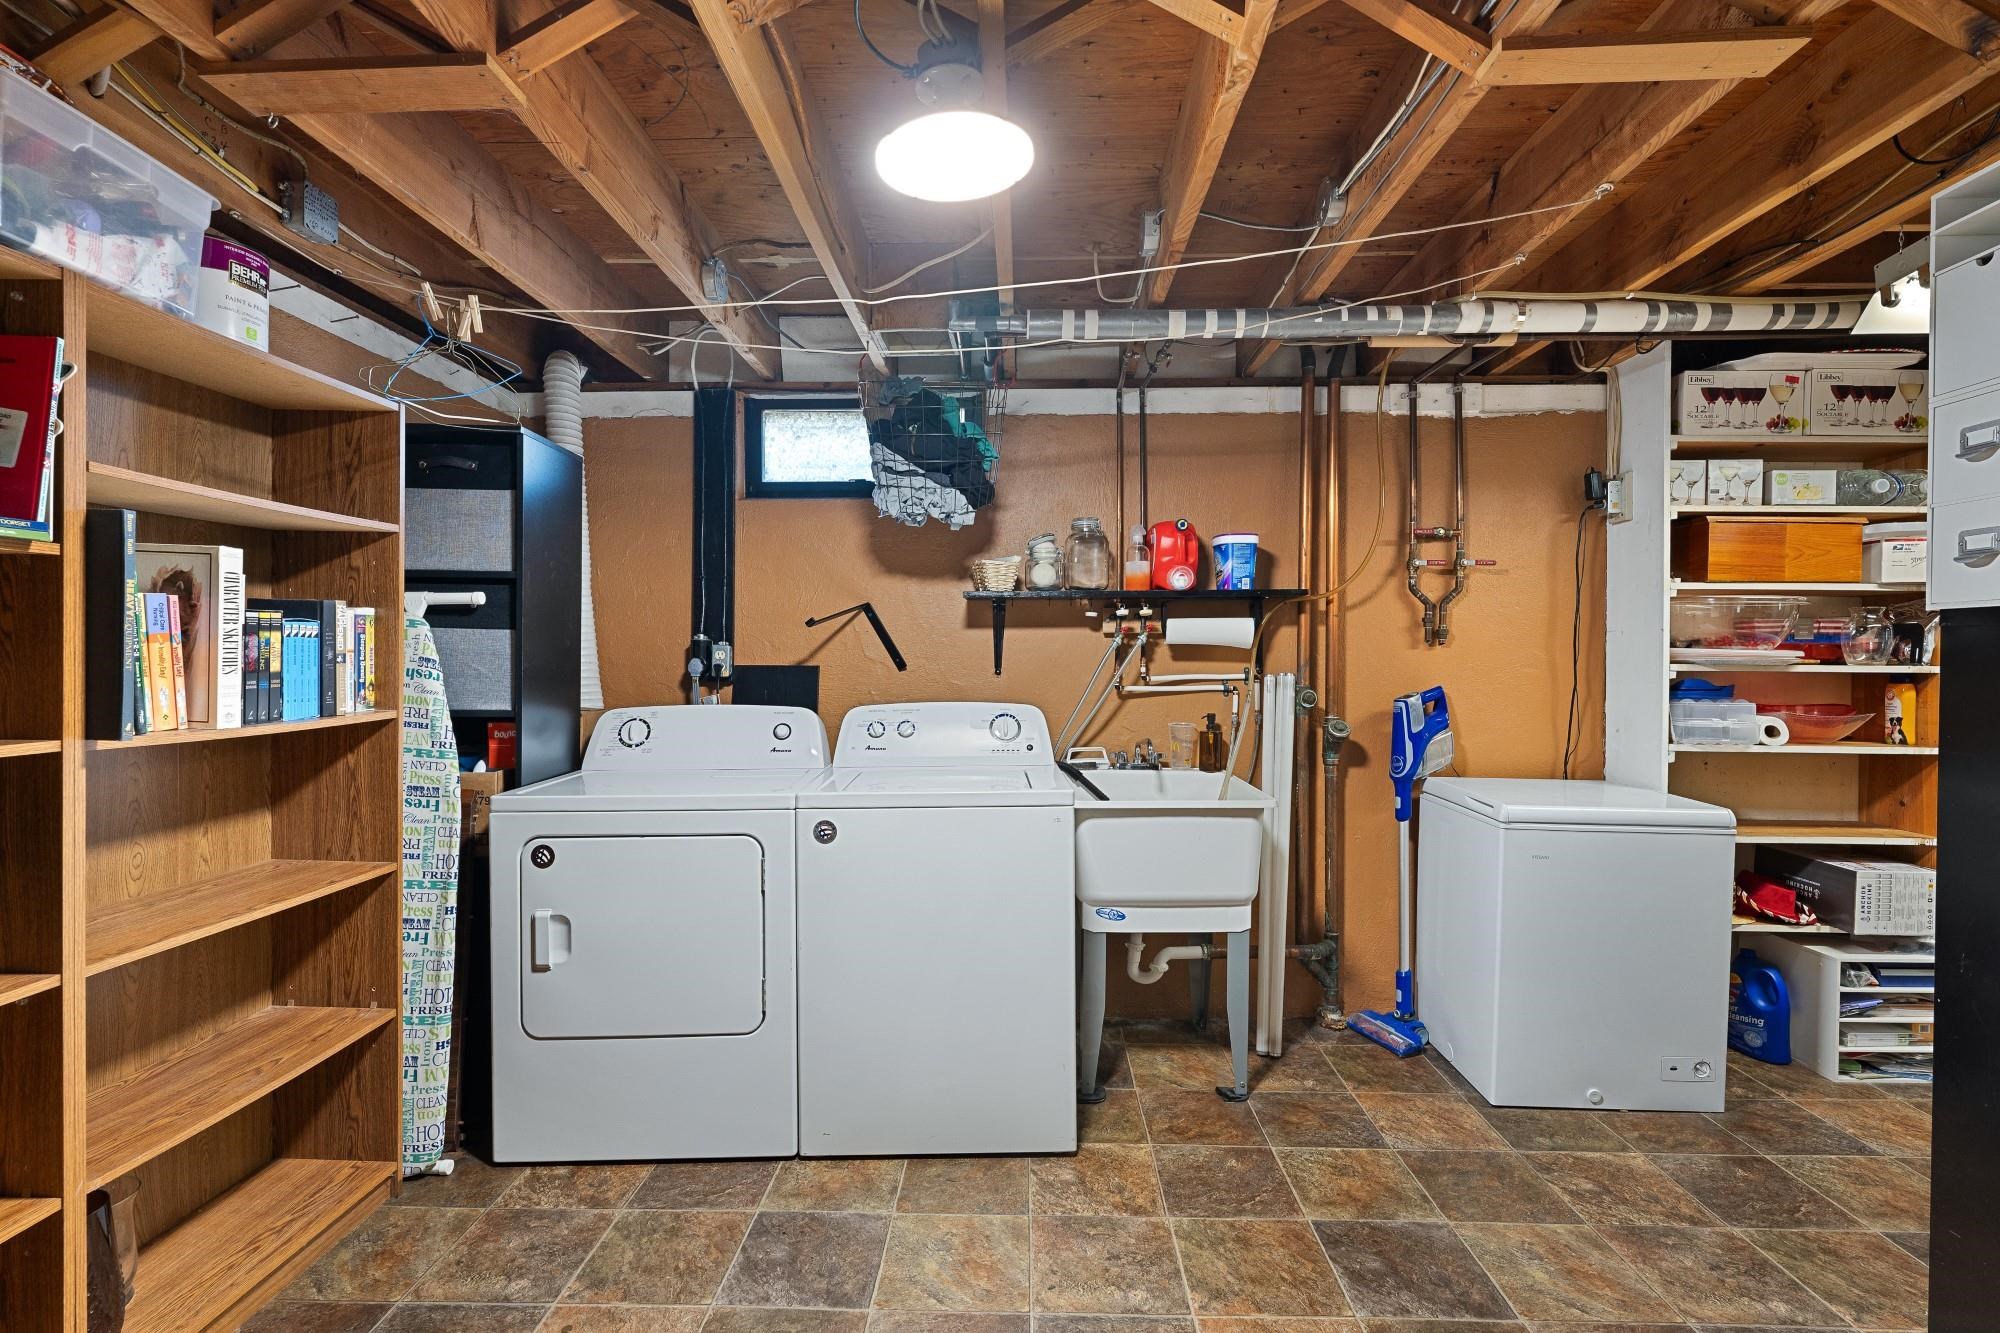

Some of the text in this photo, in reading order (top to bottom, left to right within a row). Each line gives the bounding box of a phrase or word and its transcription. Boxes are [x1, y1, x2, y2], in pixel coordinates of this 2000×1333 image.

[232, 262, 260, 282] BEHR
[231, 274, 258, 289] PREMIUM
[225, 294, 247, 305] PAINT
[1820, 374, 1841, 382] Libbey
[1824, 403, 1836, 411] 12
[125, 578, 136, 670] HEAVY EQUIPMENT
[222, 571, 240, 675] CHARACTER SKETCHES
[408, 771, 442, 785] Press
[406, 785, 440, 798] STEAM
[404, 812, 431, 824] Clean
[422, 948, 453, 957] Press
[426, 960, 453, 971] CLEAN
[424, 988, 452, 1005] HOT
[410, 1084, 445, 1095] Press
